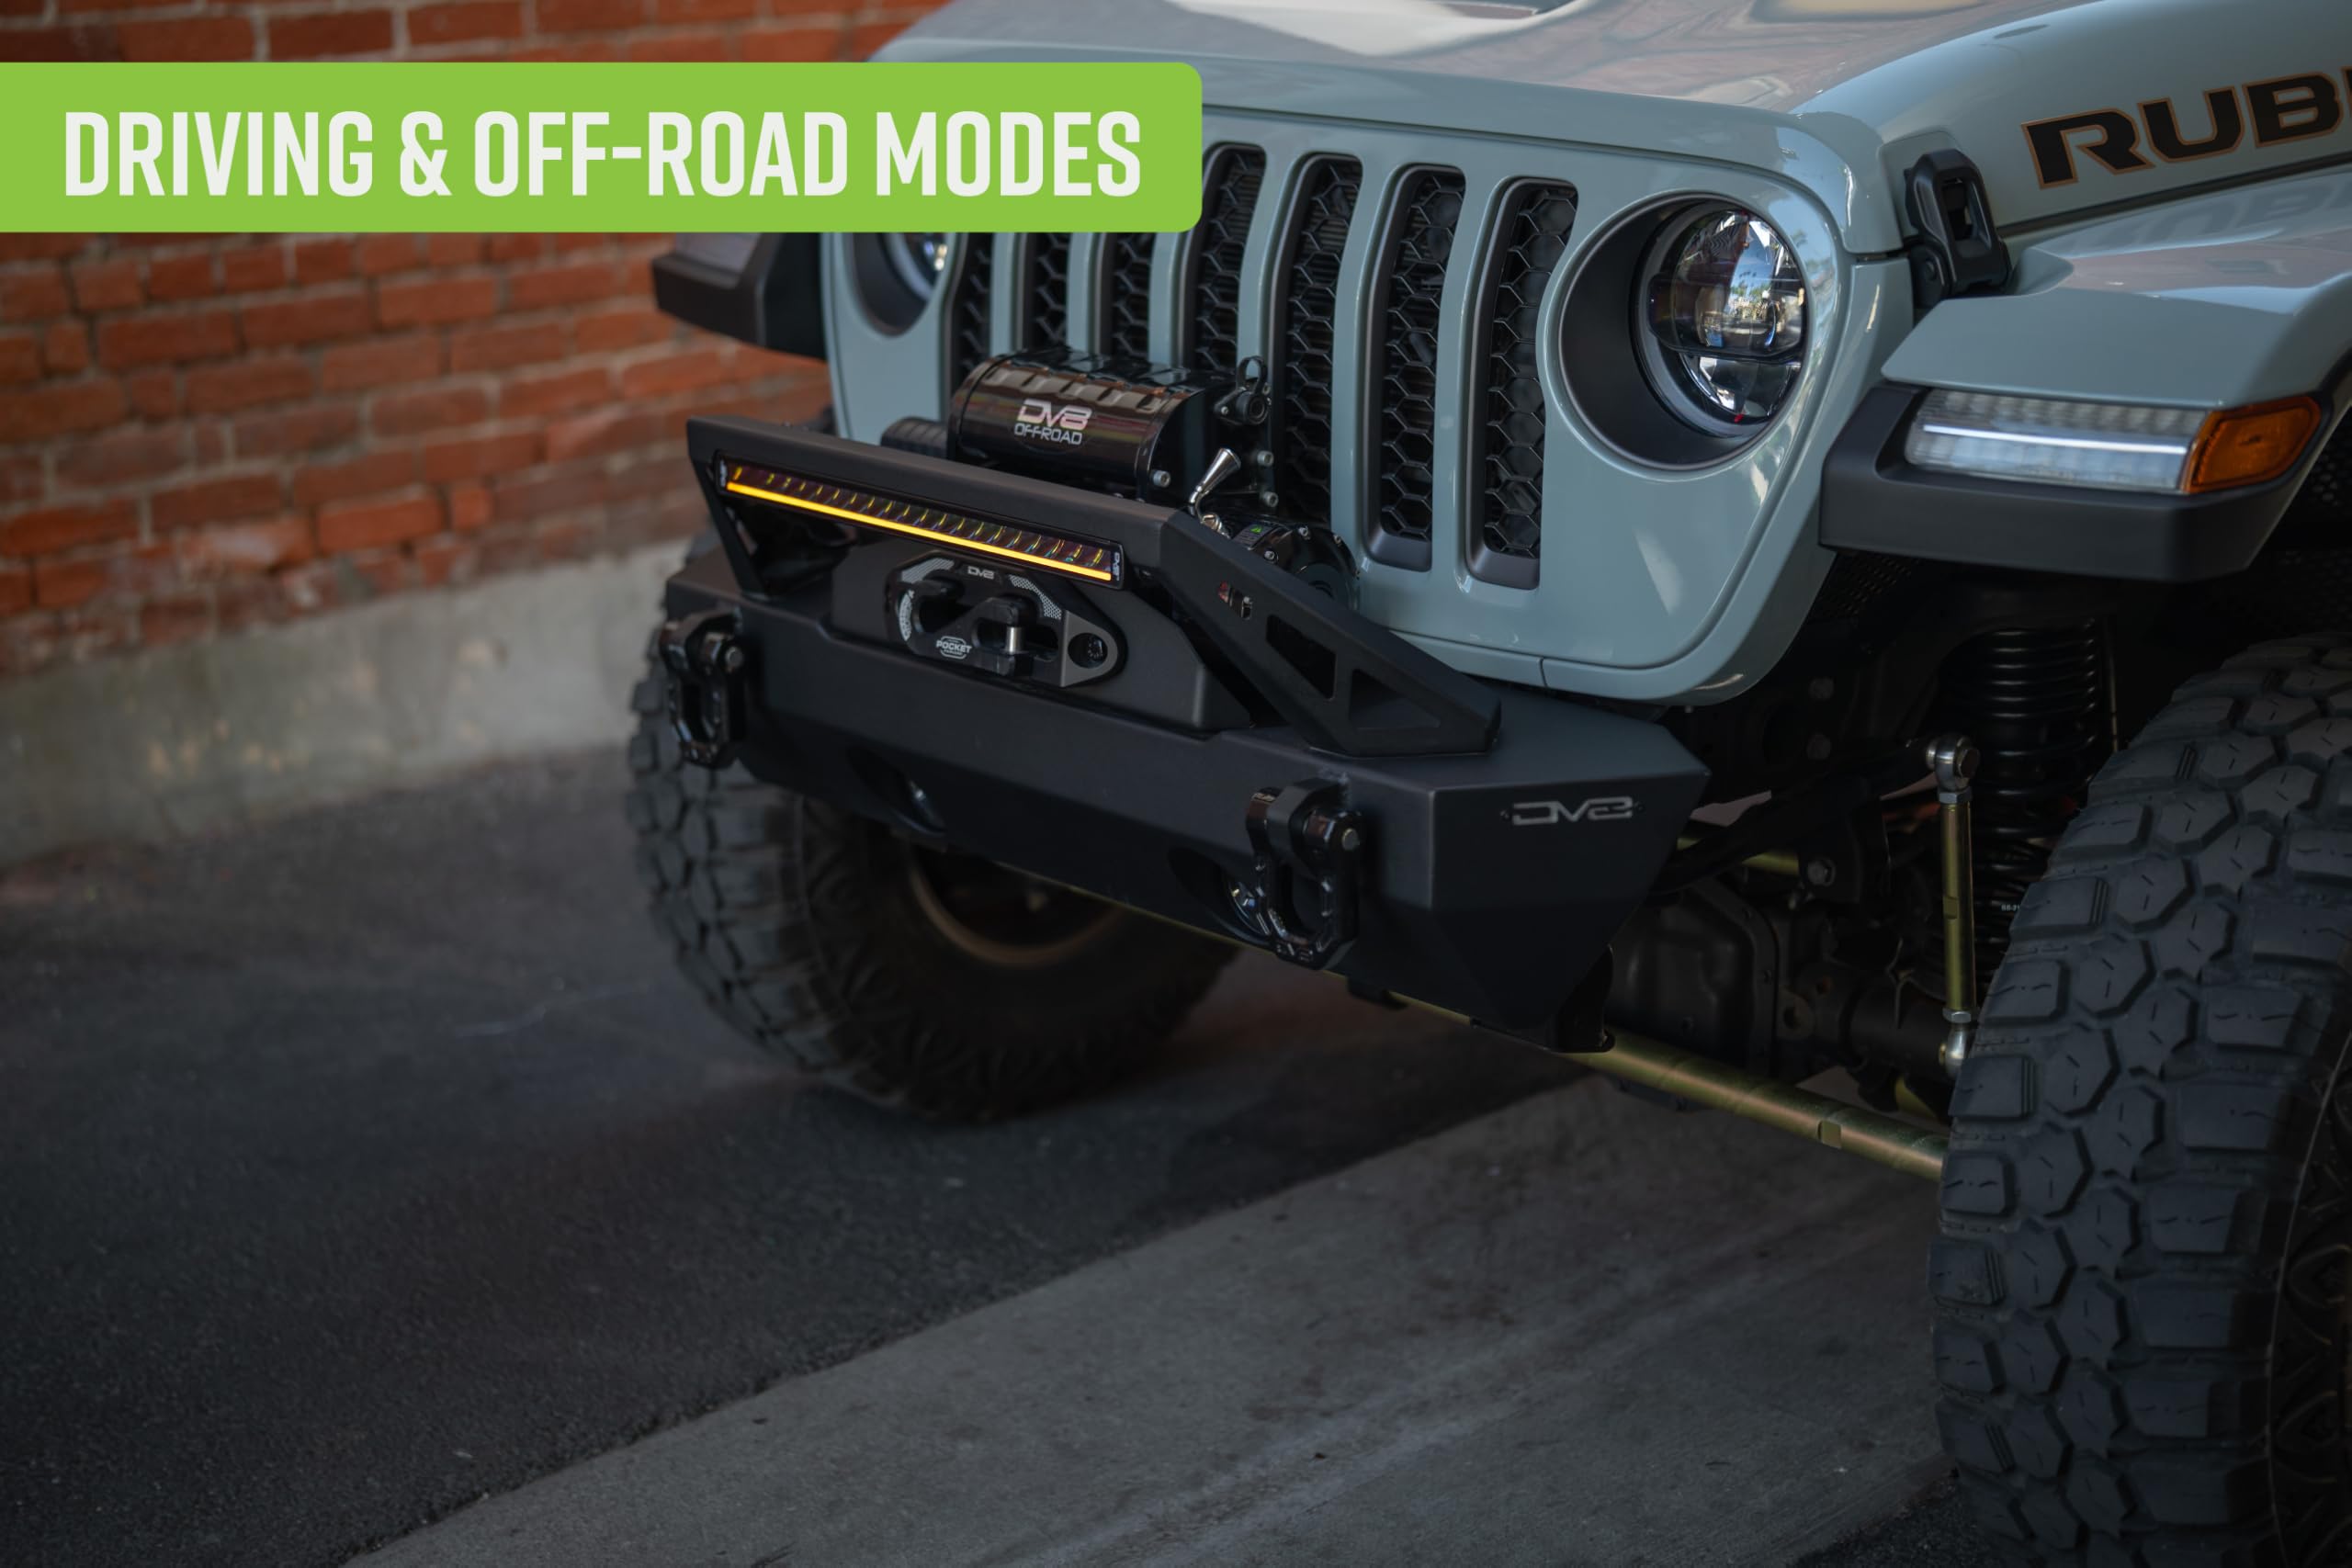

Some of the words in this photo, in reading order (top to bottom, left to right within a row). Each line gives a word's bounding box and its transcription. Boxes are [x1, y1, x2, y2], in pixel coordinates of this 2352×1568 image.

[2021, 66, 2352, 189] RUB
[1016, 399, 1092, 430] DV8
[1013, 423, 1082, 446] OFFROAD
[935, 639, 972, 653] POCKET
[1512, 795, 1633, 825] DV8
